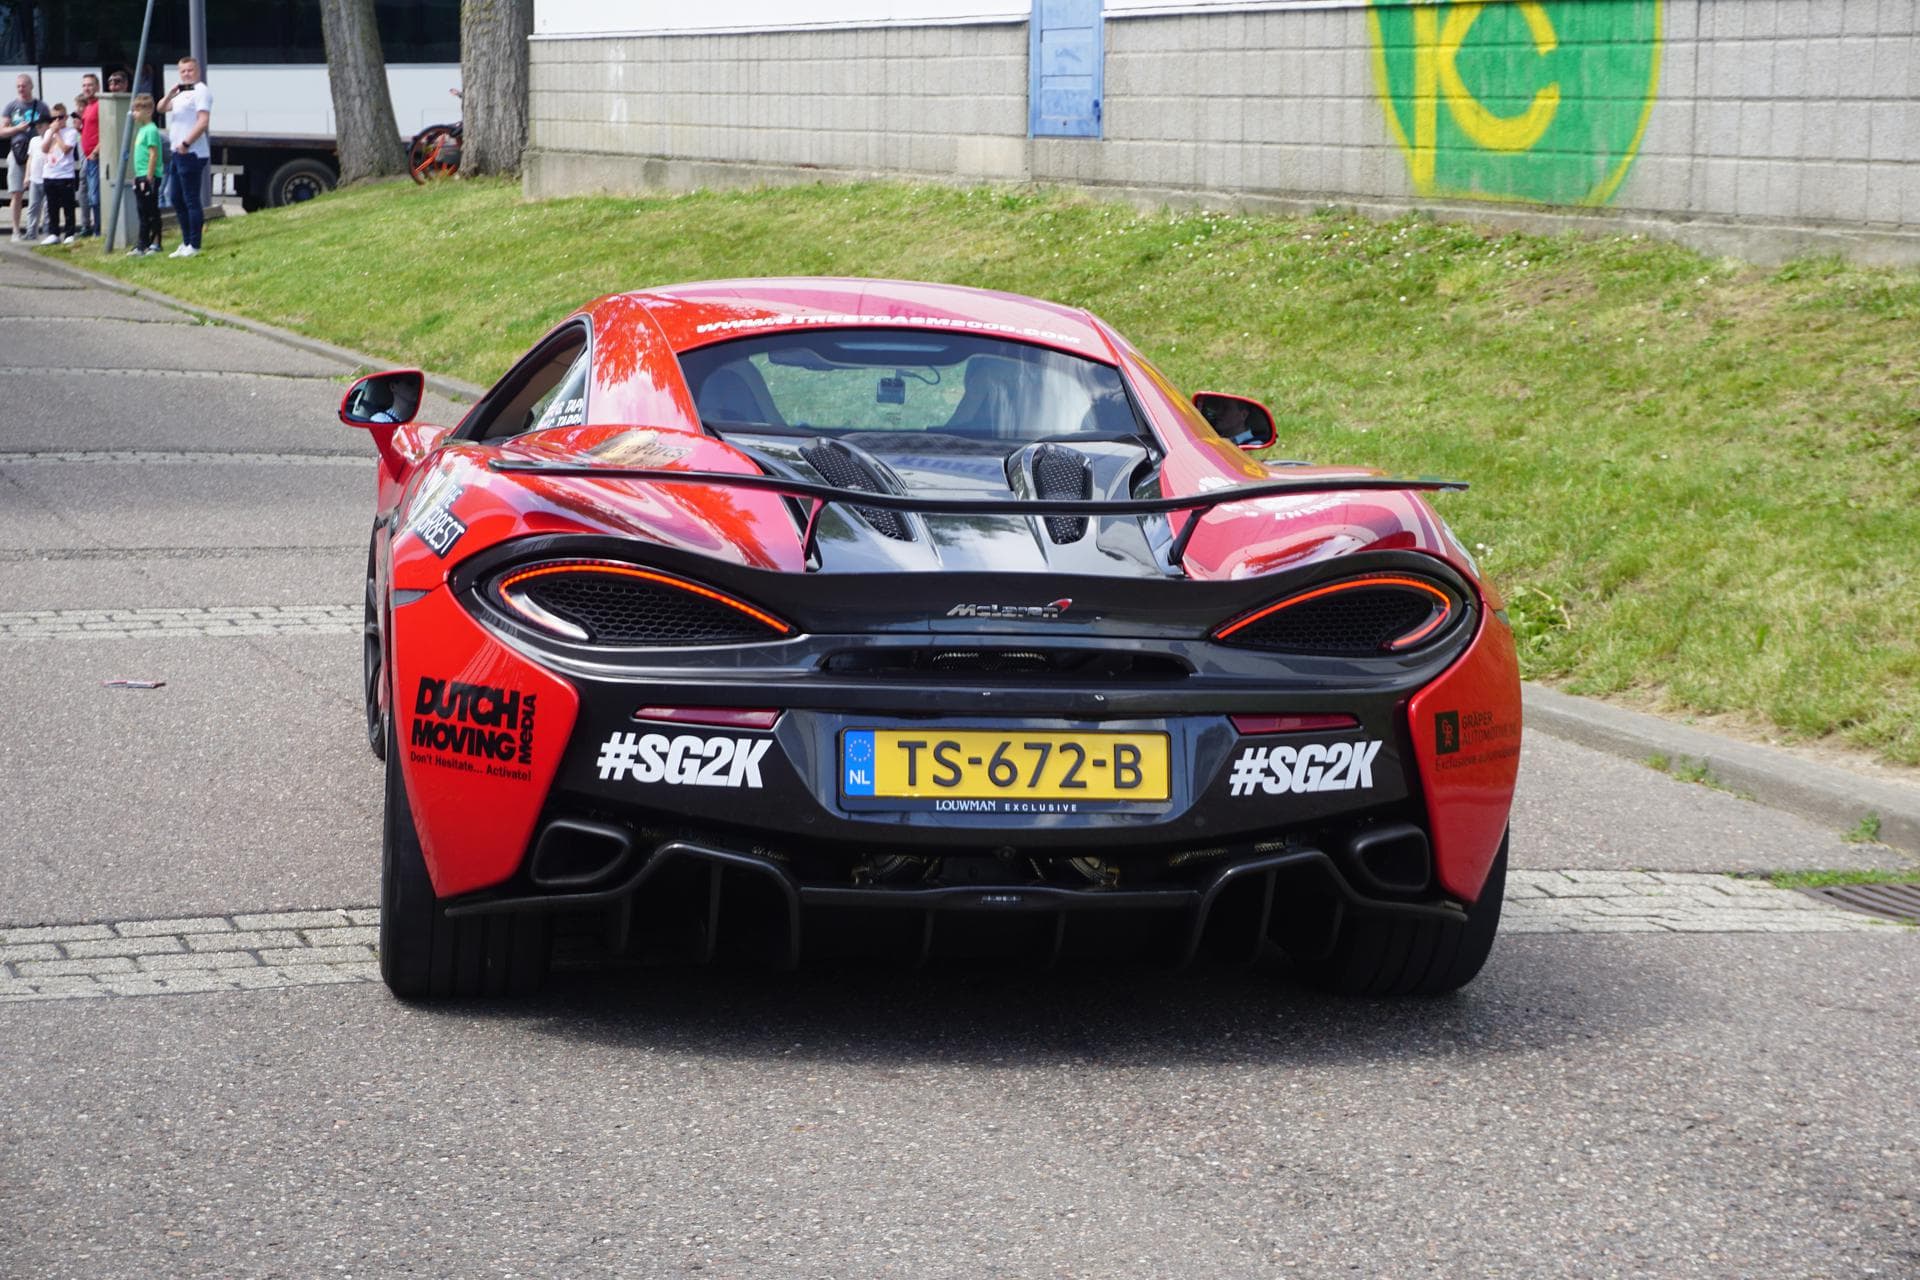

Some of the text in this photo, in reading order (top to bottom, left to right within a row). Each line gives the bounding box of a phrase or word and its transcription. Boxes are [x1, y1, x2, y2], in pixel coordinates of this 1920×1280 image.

[945, 602, 1059, 618] McLaren
[415, 676, 521, 731] DUTCH
[410, 751, 433, 765] Don't
[411, 718, 517, 761] MOVING
[596, 731, 774, 789] #SG2K
[849, 769, 871, 785] NL
[897, 740, 1143, 789] TS-672-B
[1229, 740, 1383, 796] #SG2K
[935, 800, 1078, 812] LOUWMAN EXCLUSIVE
